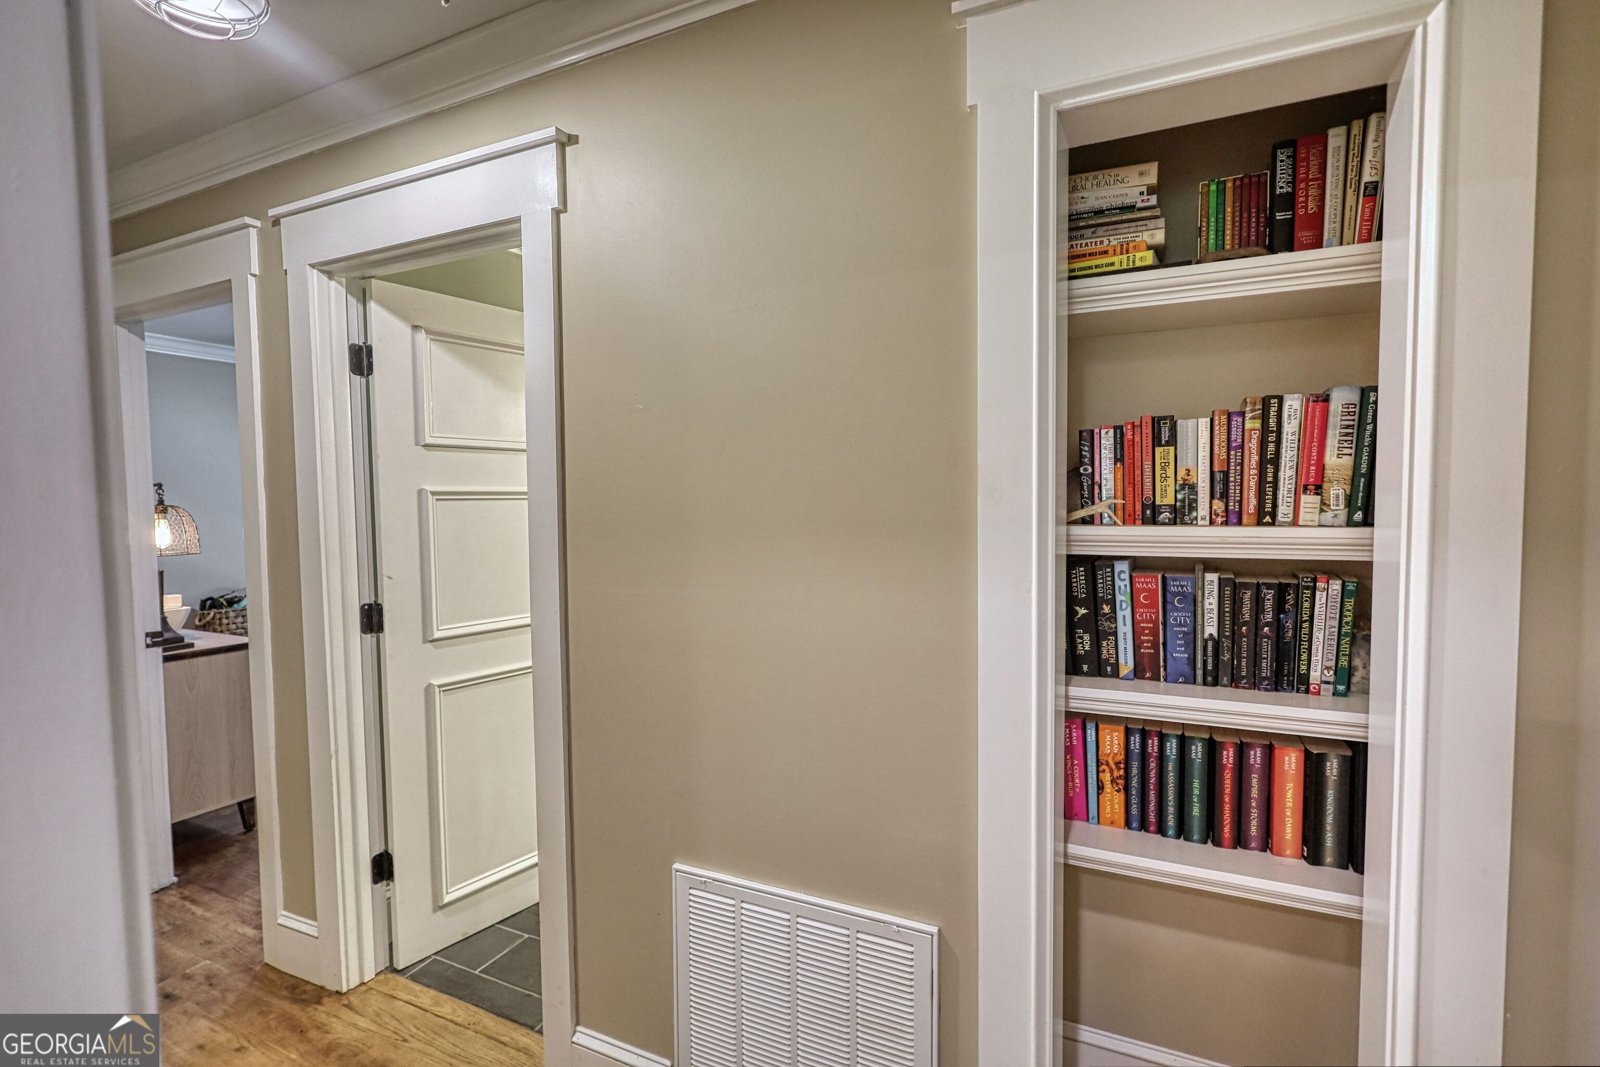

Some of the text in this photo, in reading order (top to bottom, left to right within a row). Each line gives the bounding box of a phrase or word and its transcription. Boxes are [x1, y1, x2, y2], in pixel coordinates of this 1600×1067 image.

[1372, 116, 1384, 143] Feeding
[1372, 145, 1381, 159] You
[1073, 172, 1112, 184] CHOICES
[1277, 149, 1286, 194] EXCELLENCE
[1369, 160, 1379, 177] LIES
[1091, 177, 1130, 188] HEALING
[1287, 184, 1292, 192] OF
[1364, 202, 1374, 220] Vani
[1362, 222, 1373, 239] Hari
[1269, 399, 1277, 430] STRAIGHT
[1366, 404, 1375, 423] Green
[1289, 431, 1297, 451] WILD
[1337, 402, 1358, 459] GRINNELL
[1364, 424, 1373, 445] Witch's
[1081, 441, 1090, 463] 1984
[1249, 430, 1259, 468] Dragonflies
[1360, 447, 1371, 474] GARDEN
[1143, 462, 1152, 494] FAHRENHEIT
[1160, 462, 1170, 483] Birds
[1081, 476, 1091, 498] George
[1248, 476, 1257, 513] Damselflies
[1117, 569, 1130, 627] CUDI
[1206, 580, 1215, 600] BEING
[1329, 588, 1339, 622] COYOTE
[1206, 608, 1214, 627] BEAST
[1316, 602, 1325, 634] Wildlife
[1075, 629, 1084, 655] FLAME
[1299, 590, 1311, 674] FLORIDA WILD FLOWERS
[1325, 624, 1338, 662] AMERICA
[1339, 598, 1354, 668] TROPICAL NATURE
[1219, 638, 1231, 662] Verity
[1286, 783, 1294, 807] TOWER
